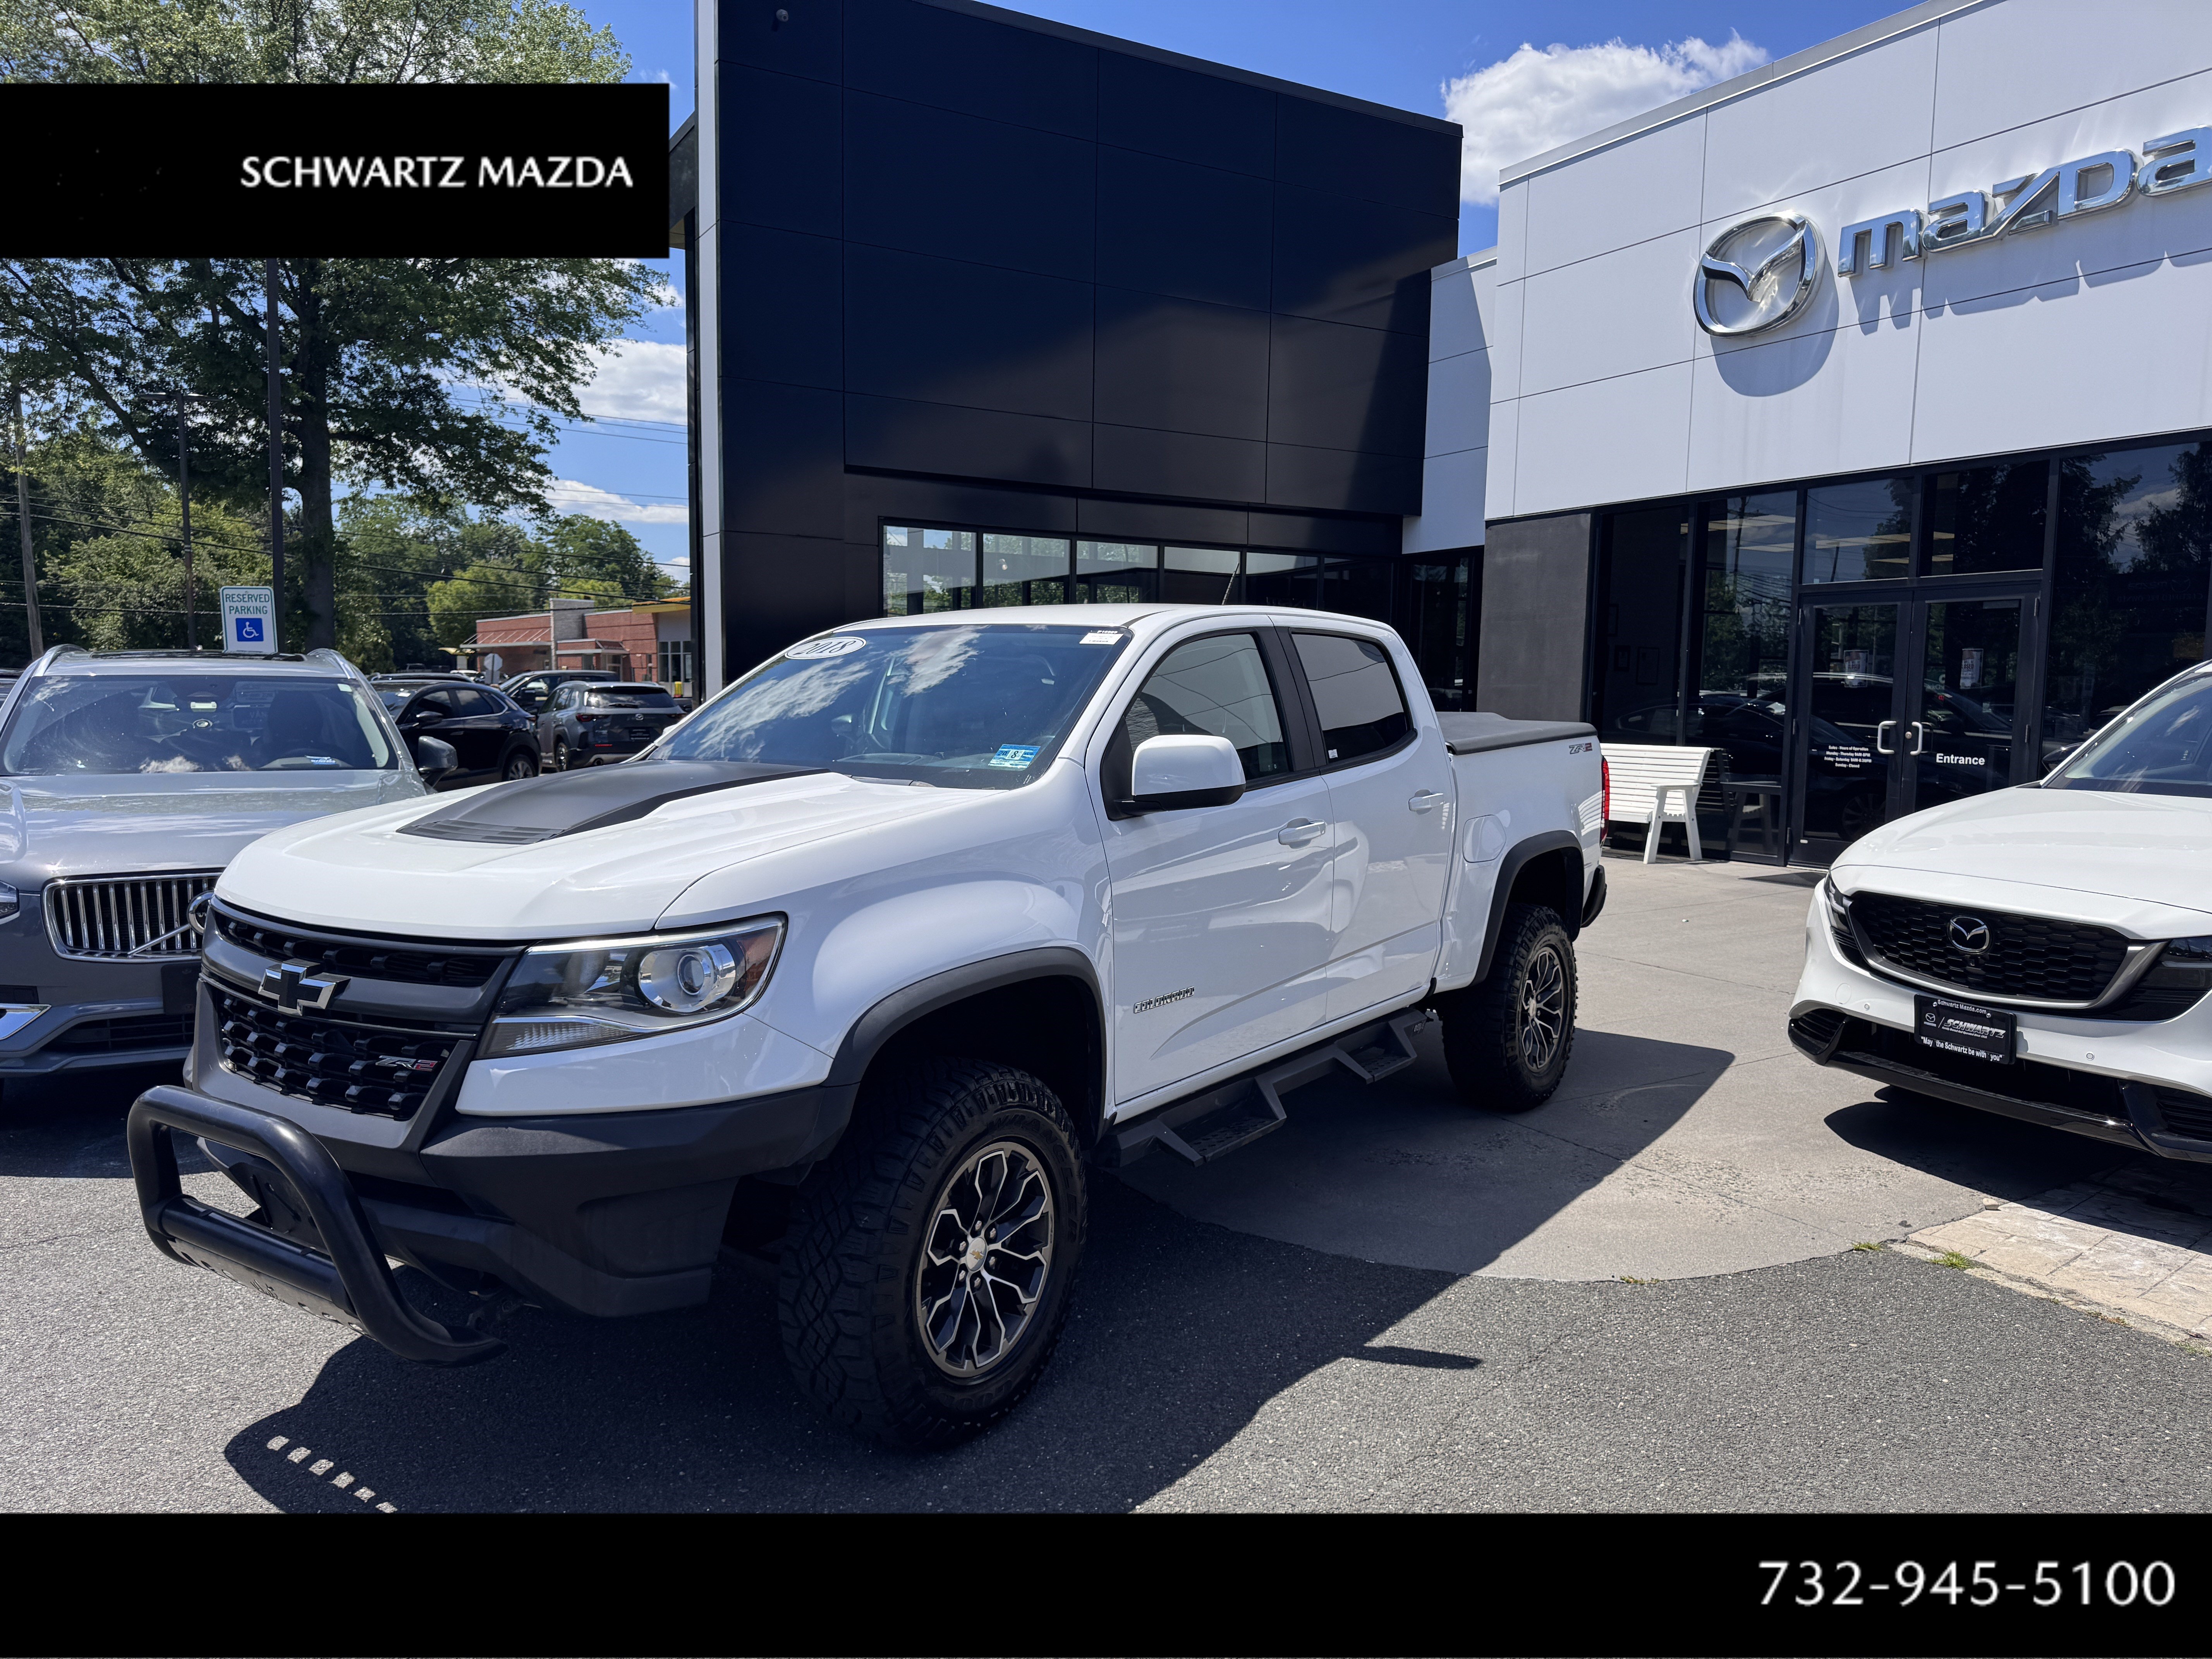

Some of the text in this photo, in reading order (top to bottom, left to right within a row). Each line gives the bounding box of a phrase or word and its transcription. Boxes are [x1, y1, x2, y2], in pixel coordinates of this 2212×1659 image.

[225, 594, 270, 603] RESERVED
[229, 606, 268, 615] PARKING
[792, 641, 856, 655] 2018
[1569, 743, 1592, 754] ZR2
[1936, 753, 1985, 765] Entrance
[1133, 986, 1195, 1013] COLORADO
[1937, 1000, 1987, 1014] Schwartz Mazda.com
[1944, 1019, 2006, 1038] SCHWARTZ
[1945, 1042, 1967, 1054] Schwartz
[1968, 1047, 1975, 1055] be
[1975, 1050, 1986, 1058] with
[375, 1055, 438, 1072] ZR2
